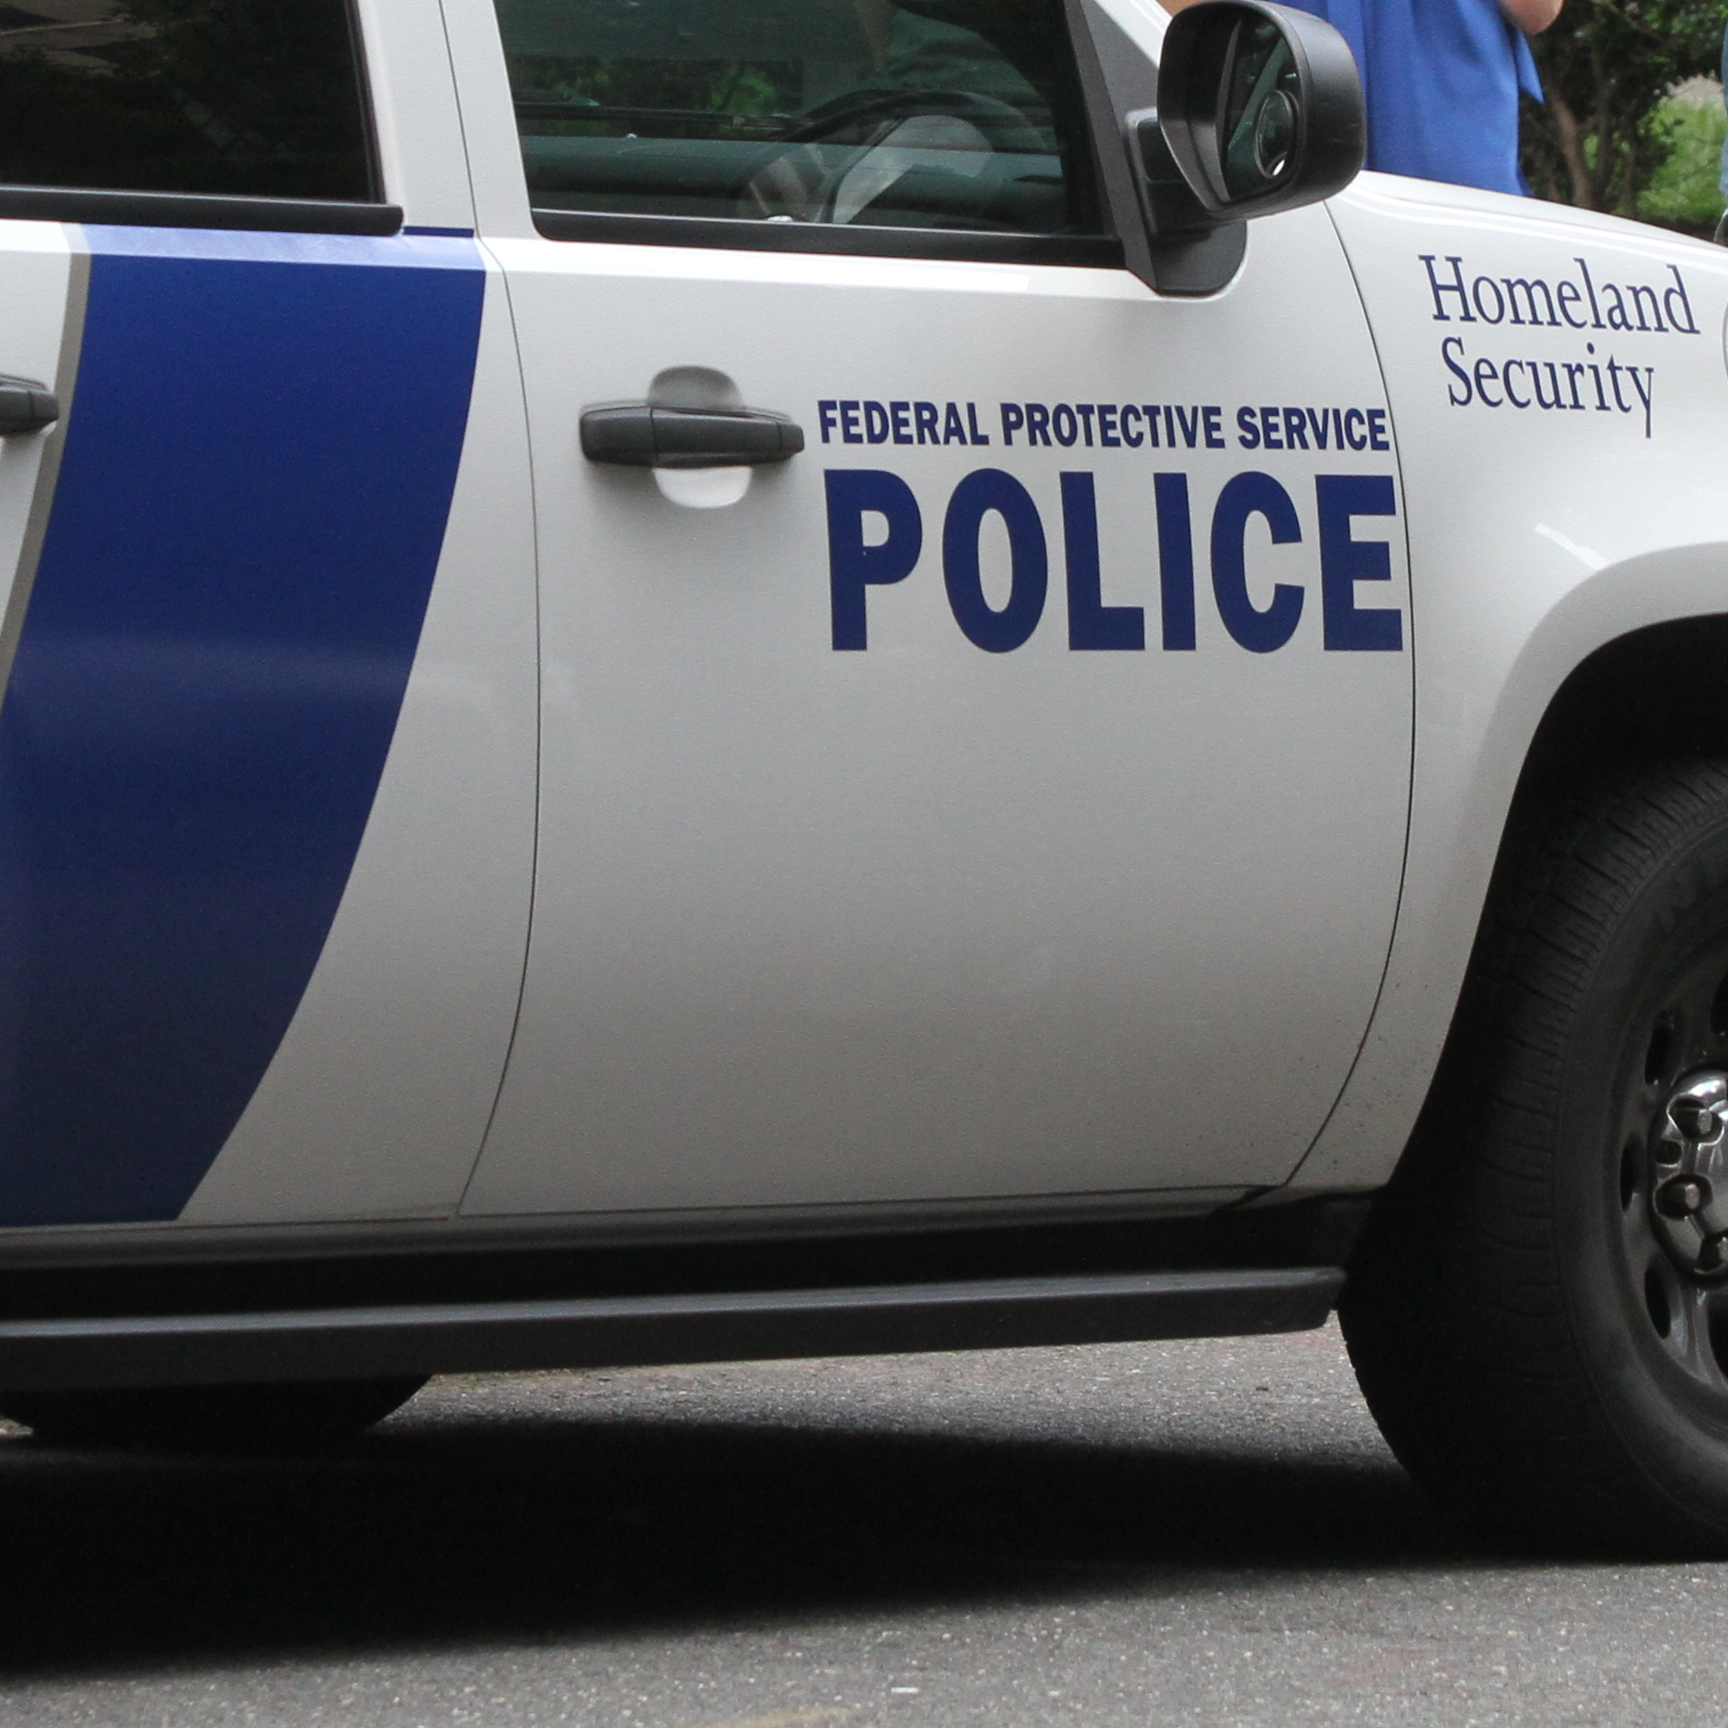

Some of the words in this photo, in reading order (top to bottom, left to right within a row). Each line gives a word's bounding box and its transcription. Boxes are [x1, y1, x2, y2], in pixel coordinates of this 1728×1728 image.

[1417, 254, 1701, 335] Homeland
[817, 399, 990, 446] FEDERAL
[999, 402, 1226, 449] PROTECTIVE
[1236, 405, 1391, 452] SERVICE
[1440, 335, 1655, 439] Security
[822, 467, 1404, 655] POLICE
